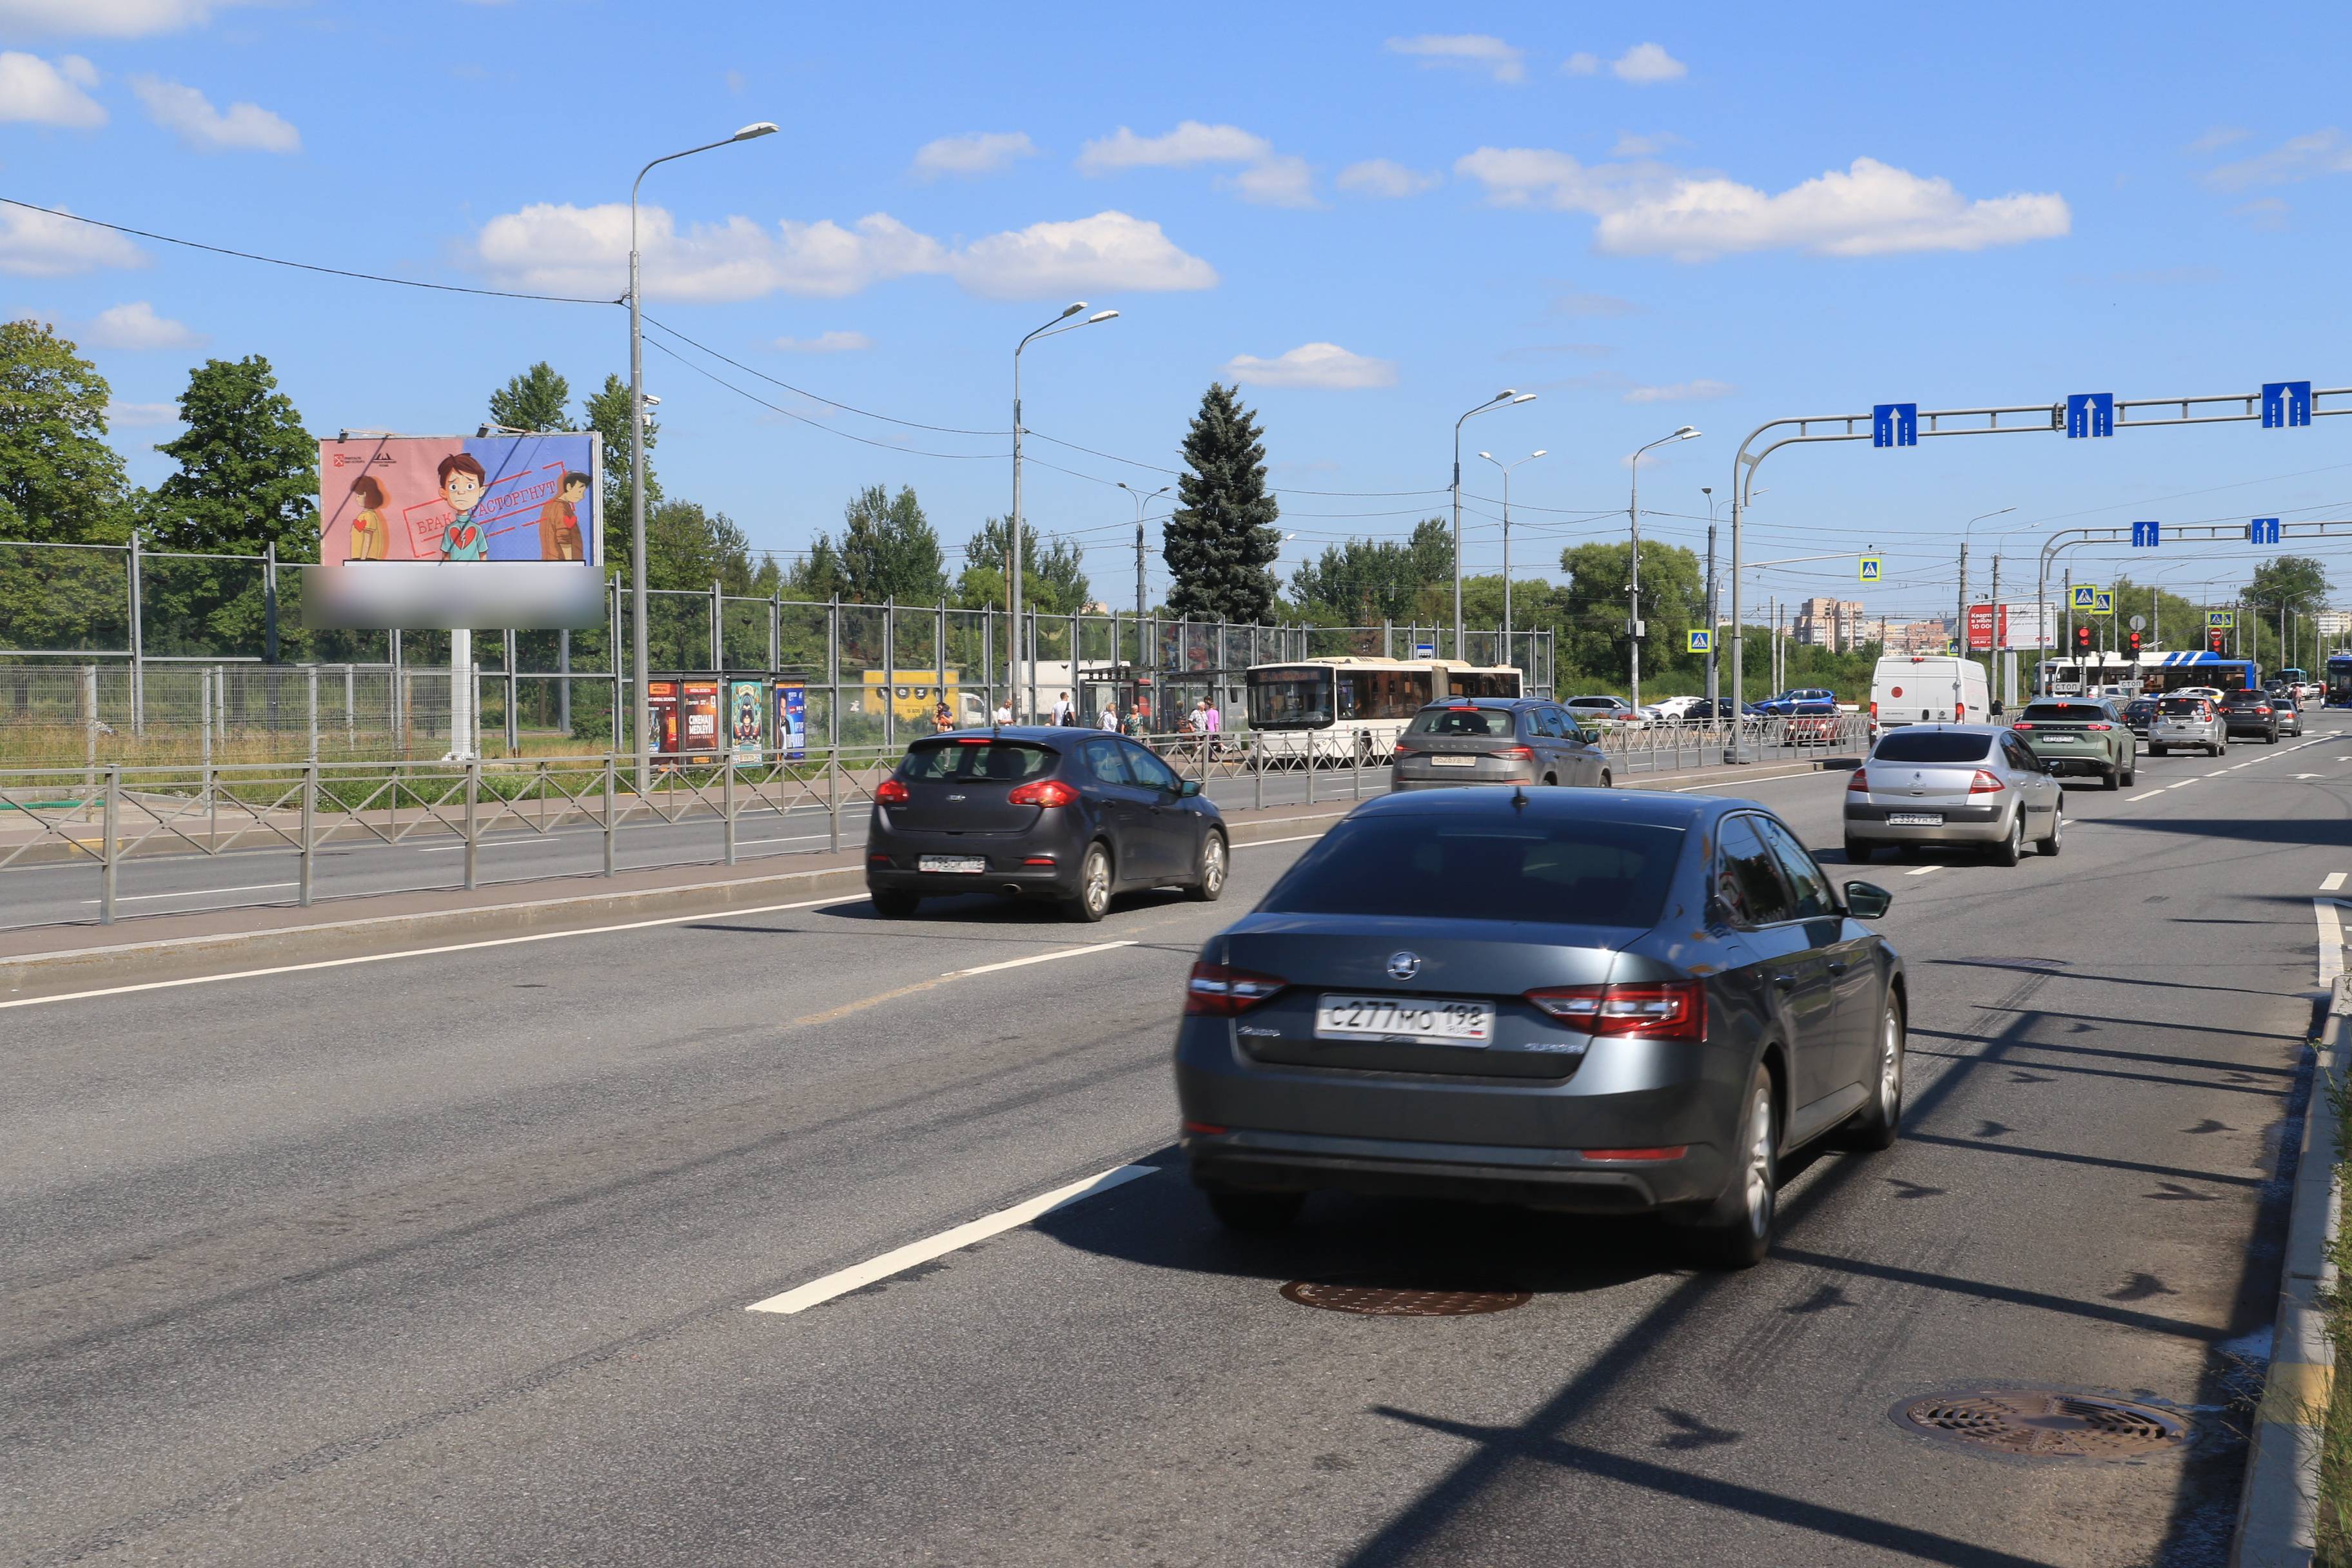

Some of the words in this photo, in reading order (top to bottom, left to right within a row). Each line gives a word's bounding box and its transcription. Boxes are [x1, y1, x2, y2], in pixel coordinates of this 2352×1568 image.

[416, 513, 451, 534] БРАК
[470, 480, 556, 518] РАСТОРГНУТ
[689, 714, 708, 725] CINEMA
[689, 725, 708, 735] MEDLEY
